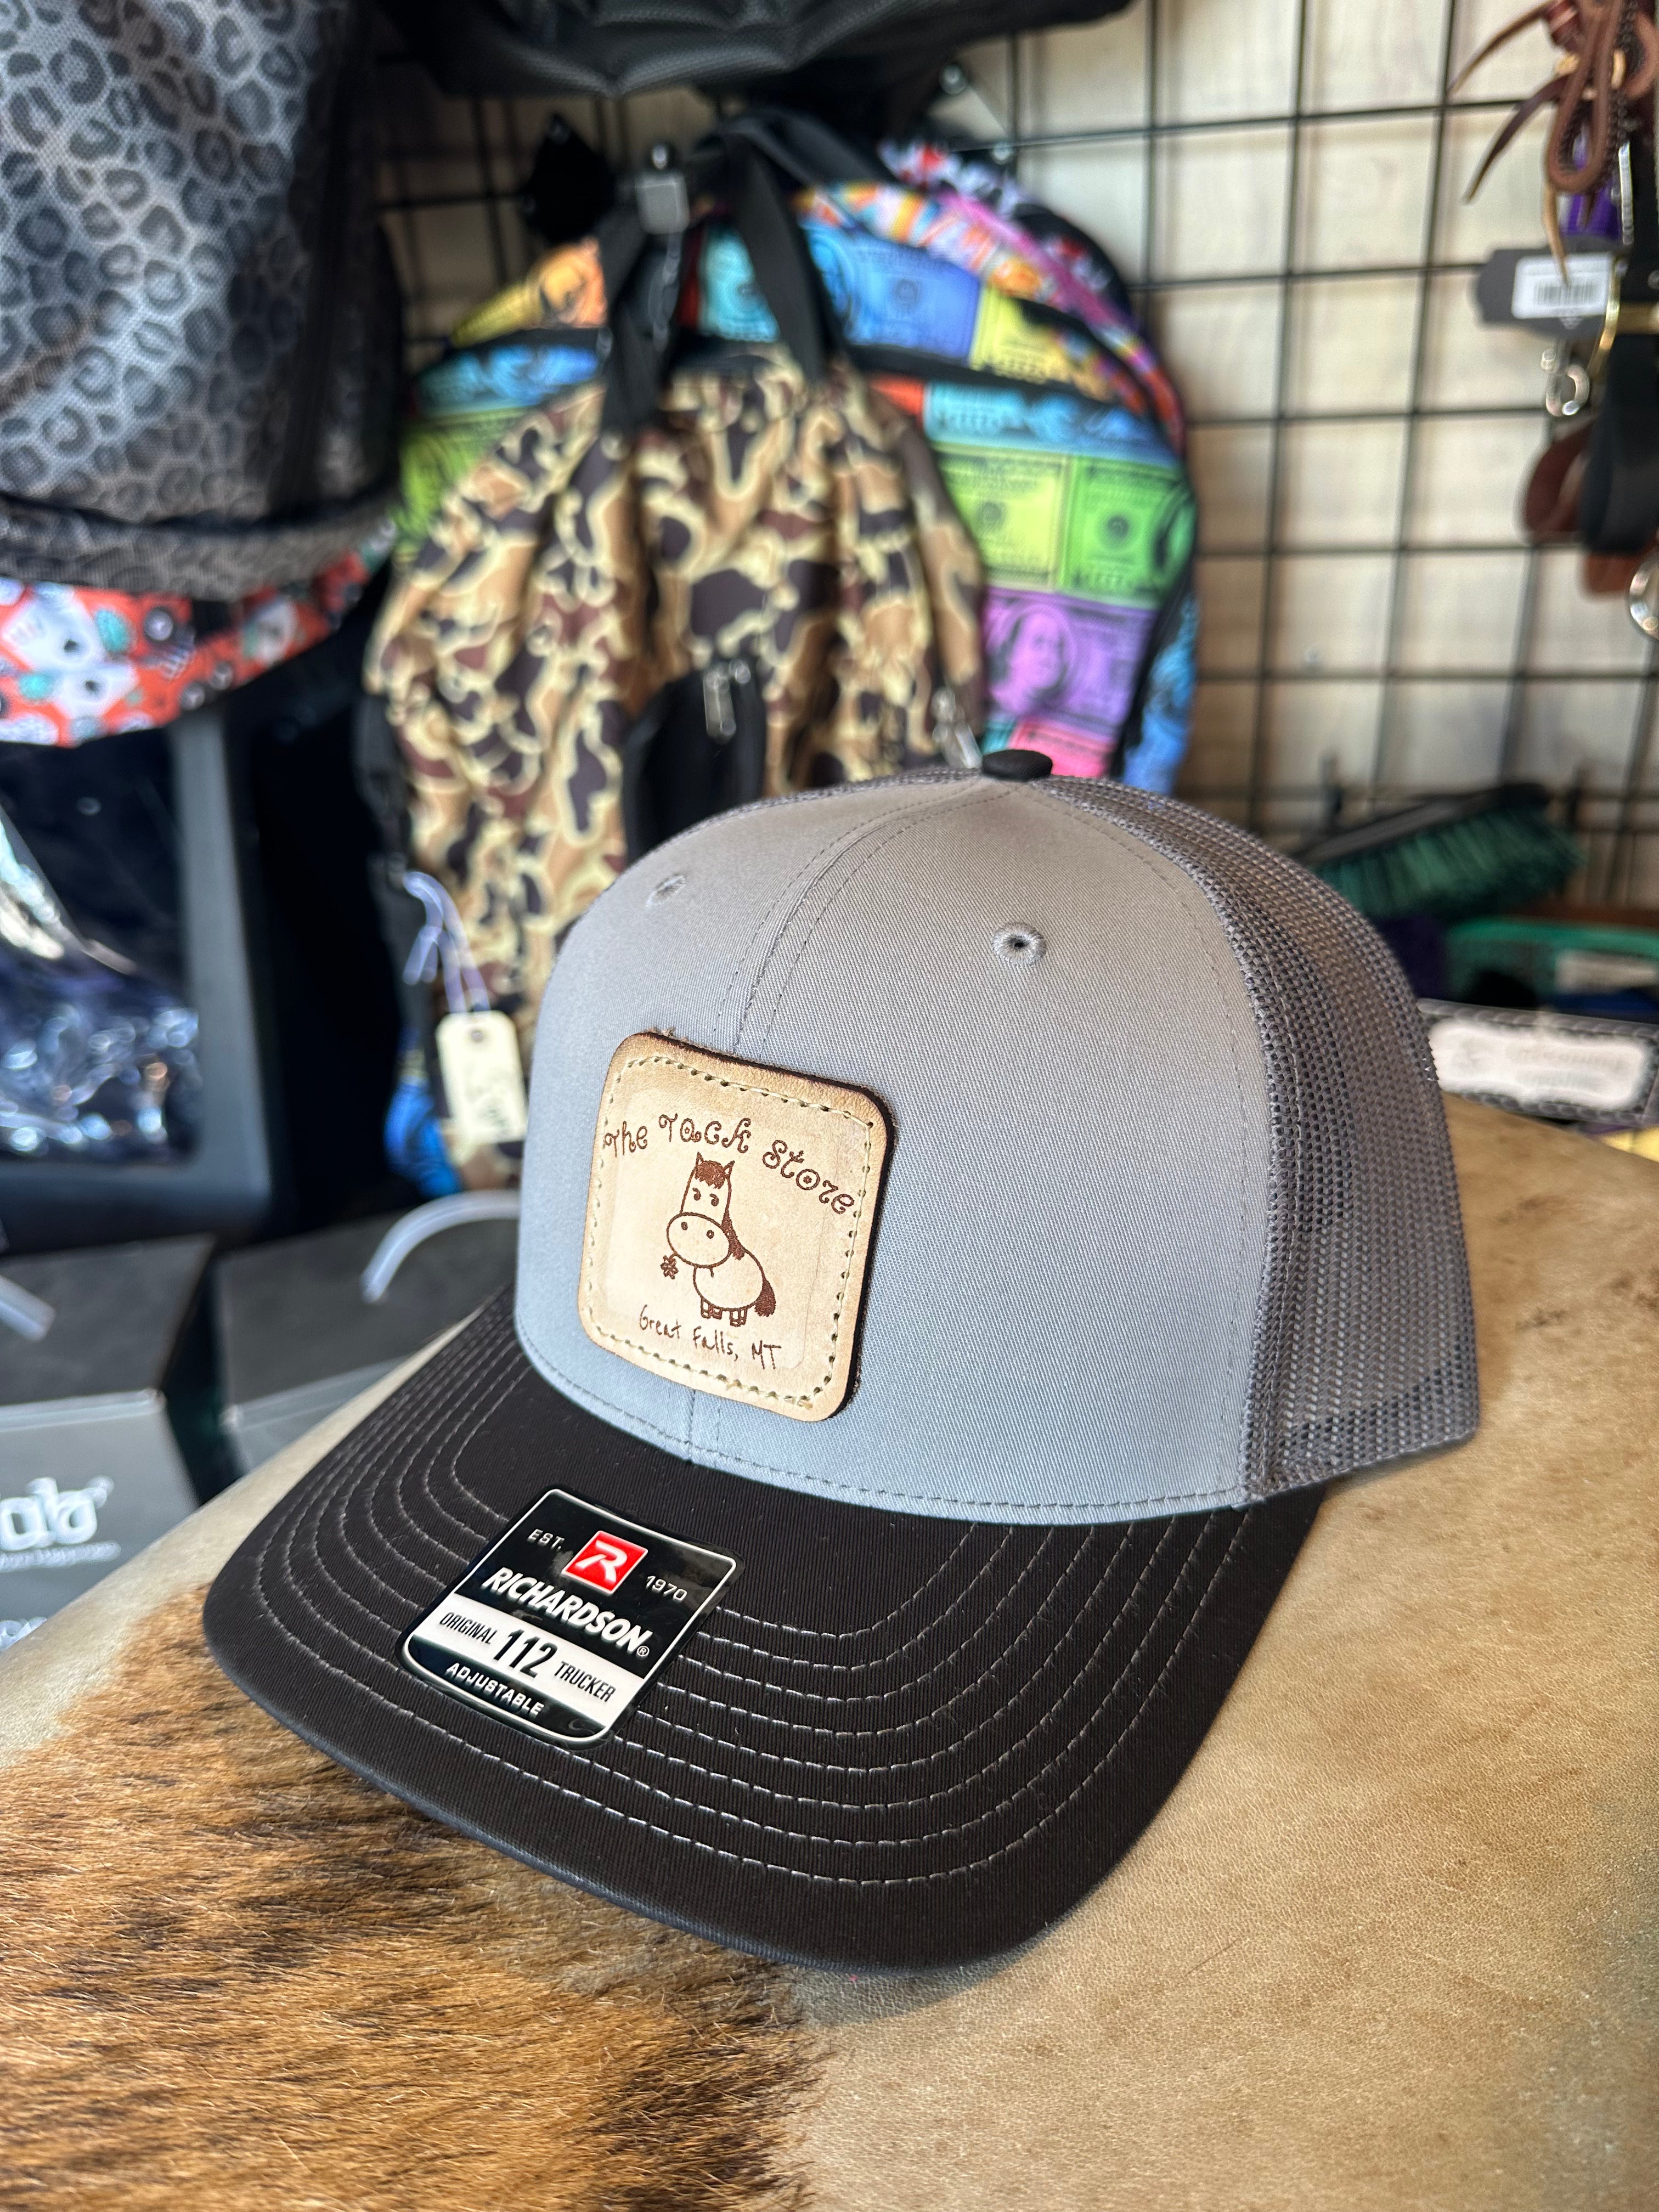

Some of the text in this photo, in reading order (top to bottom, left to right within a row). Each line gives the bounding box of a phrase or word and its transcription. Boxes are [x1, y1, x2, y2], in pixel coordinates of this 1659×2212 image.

[605, 1120, 648, 1158] The
[762, 1139, 855, 1215] Store
[639, 1304, 782, 1369] Great Falls, MT
[528, 1528, 565, 1551] EST.
[646, 1575, 688, 1601] 1970
[439, 1611, 617, 1703] ORIGINAL 112 TRUCKER
[445, 1662, 545, 1716] ADJUSTABLE
